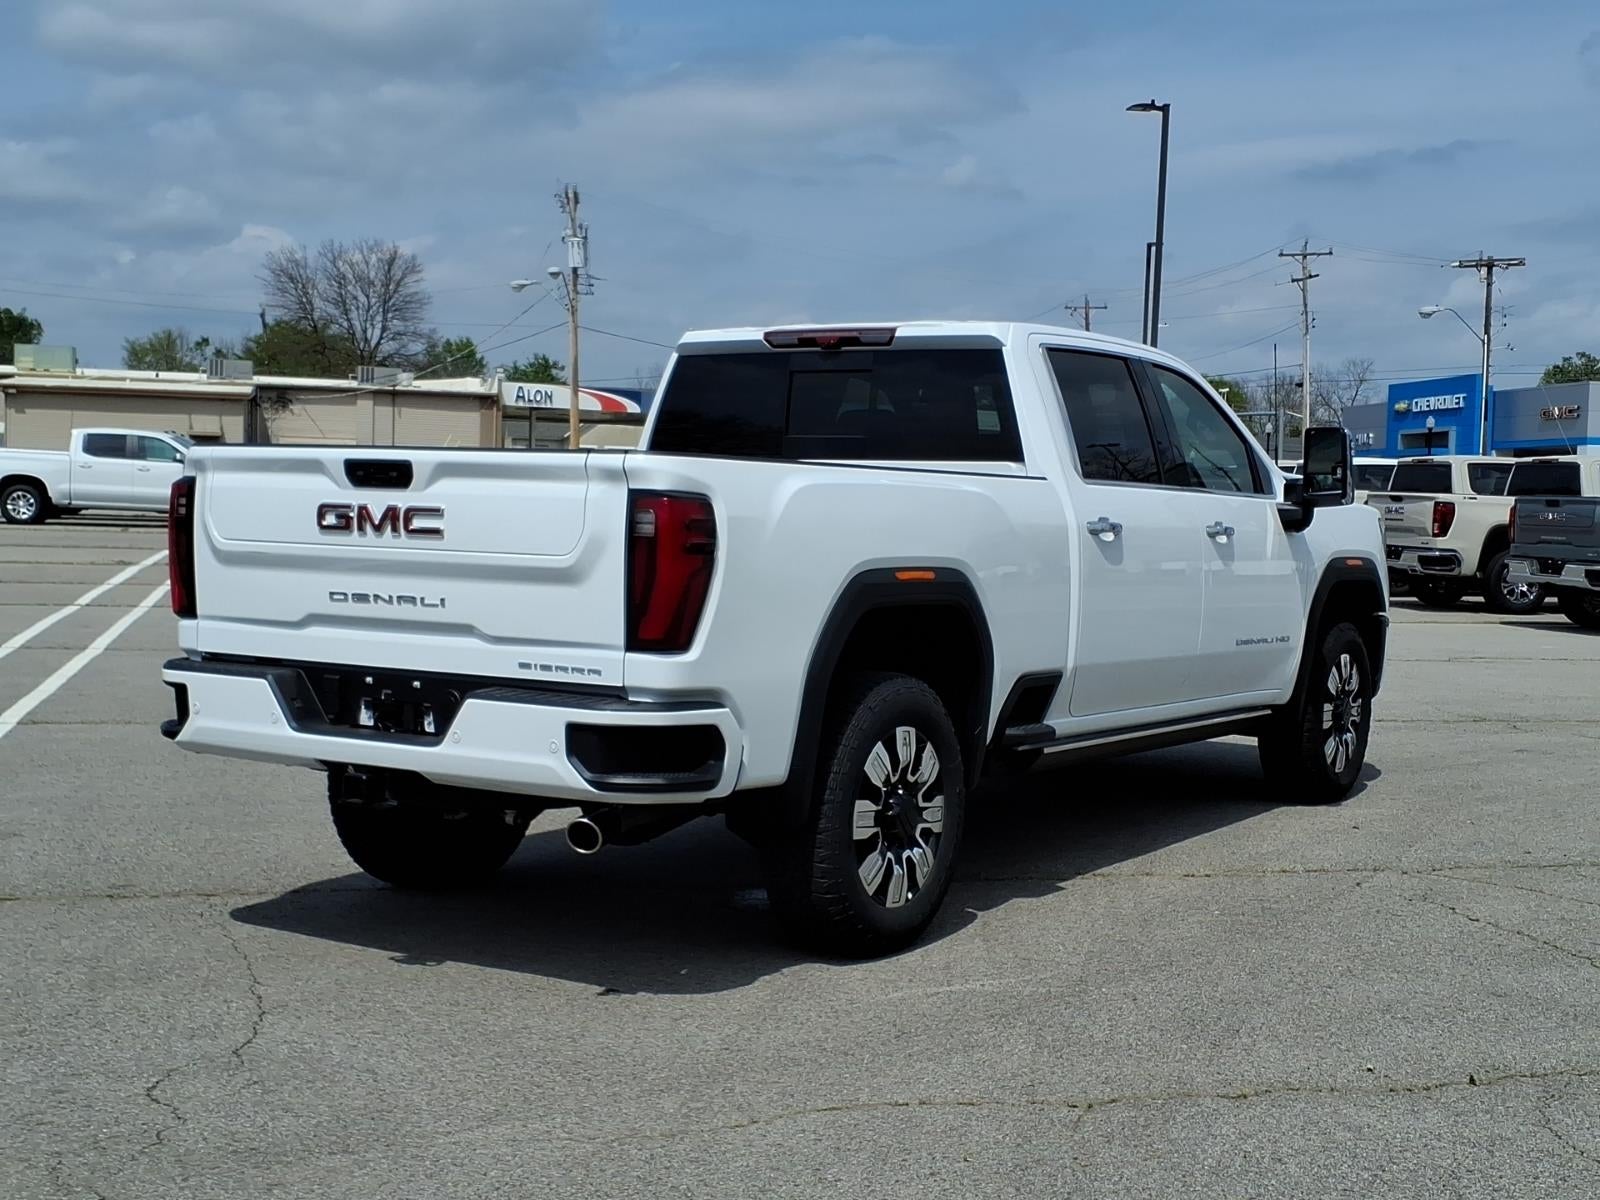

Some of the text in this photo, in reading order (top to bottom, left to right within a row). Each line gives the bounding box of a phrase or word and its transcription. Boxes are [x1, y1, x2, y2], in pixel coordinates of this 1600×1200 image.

[1412, 393, 1467, 413] CHEVROLET
[1539, 404, 1580, 420] GMC
[316, 501, 445, 541] GMC
[328, 591, 446, 609] DENALI
[518, 661, 602, 677] SIERRA
